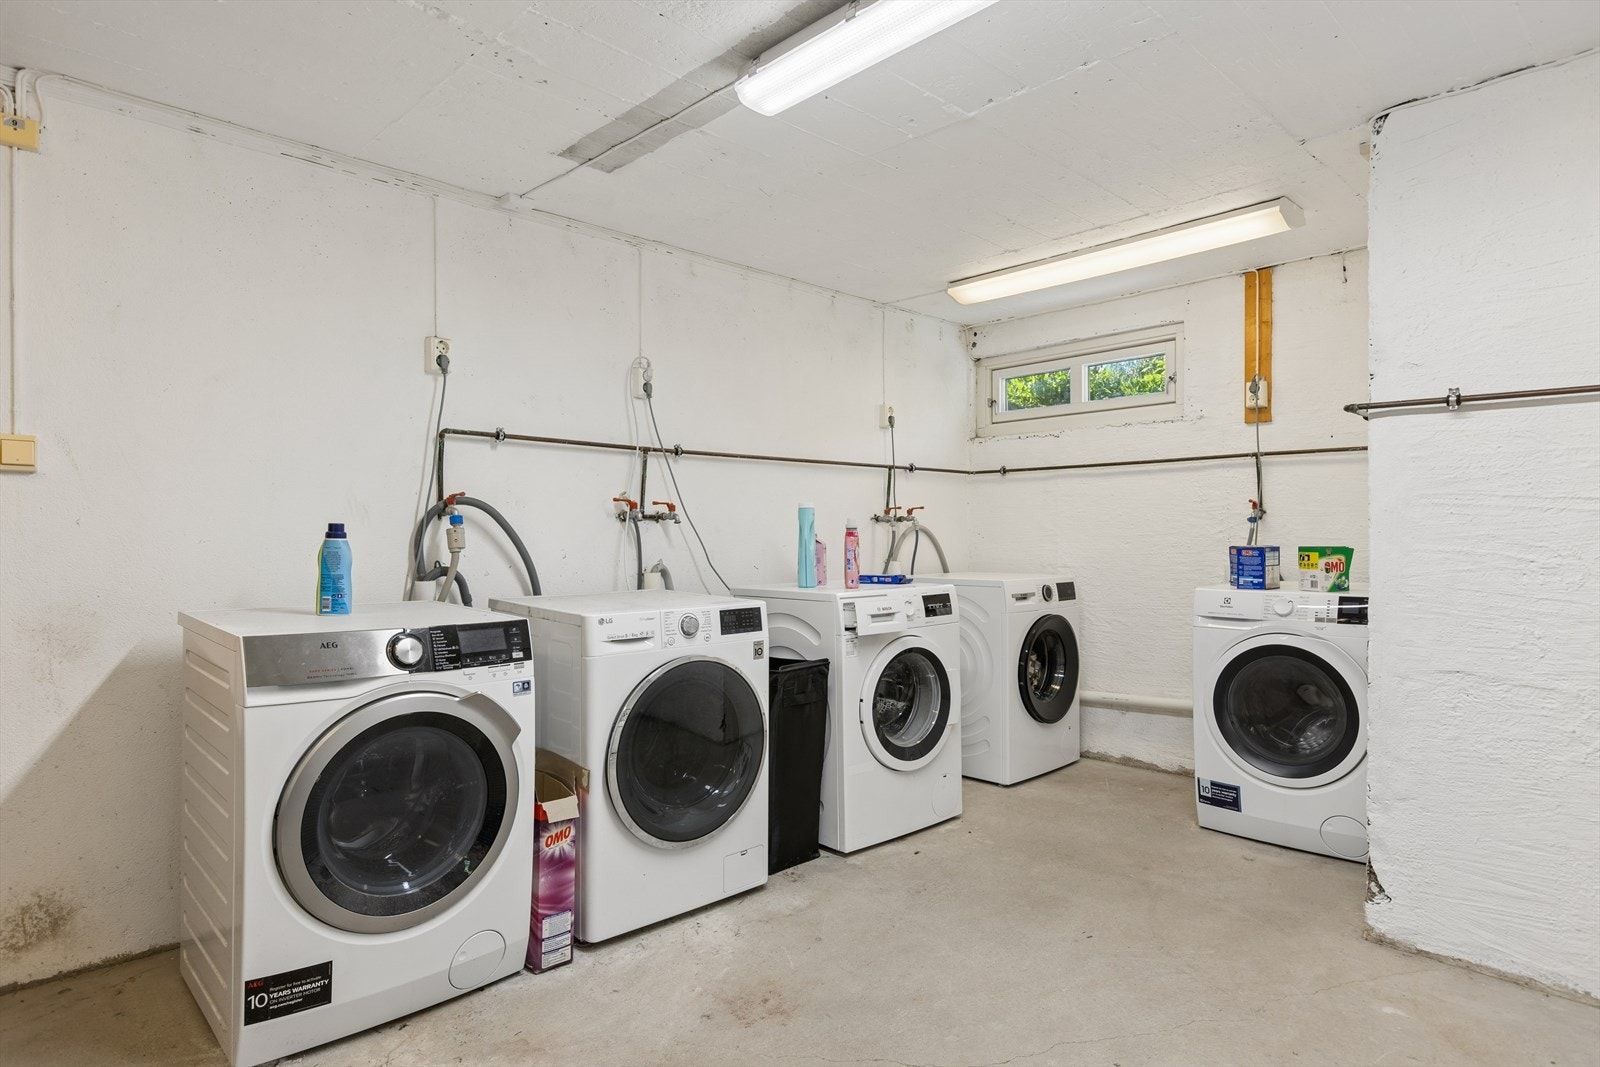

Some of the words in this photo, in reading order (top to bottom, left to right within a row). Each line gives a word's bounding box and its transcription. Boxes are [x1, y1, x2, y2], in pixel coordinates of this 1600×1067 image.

[1324, 561, 1345, 574] OMO
[320, 641, 338, 649] AEG
[1201, 785, 1210, 795] 10
[545, 825, 572, 849] OMO
[269, 988, 291, 999] YEARS
[291, 978, 330, 994] WARRANTY
[278, 992, 303, 1002] INVERTER
[302, 987, 321, 996] MOTOR
[247, 992, 268, 1010] 10
